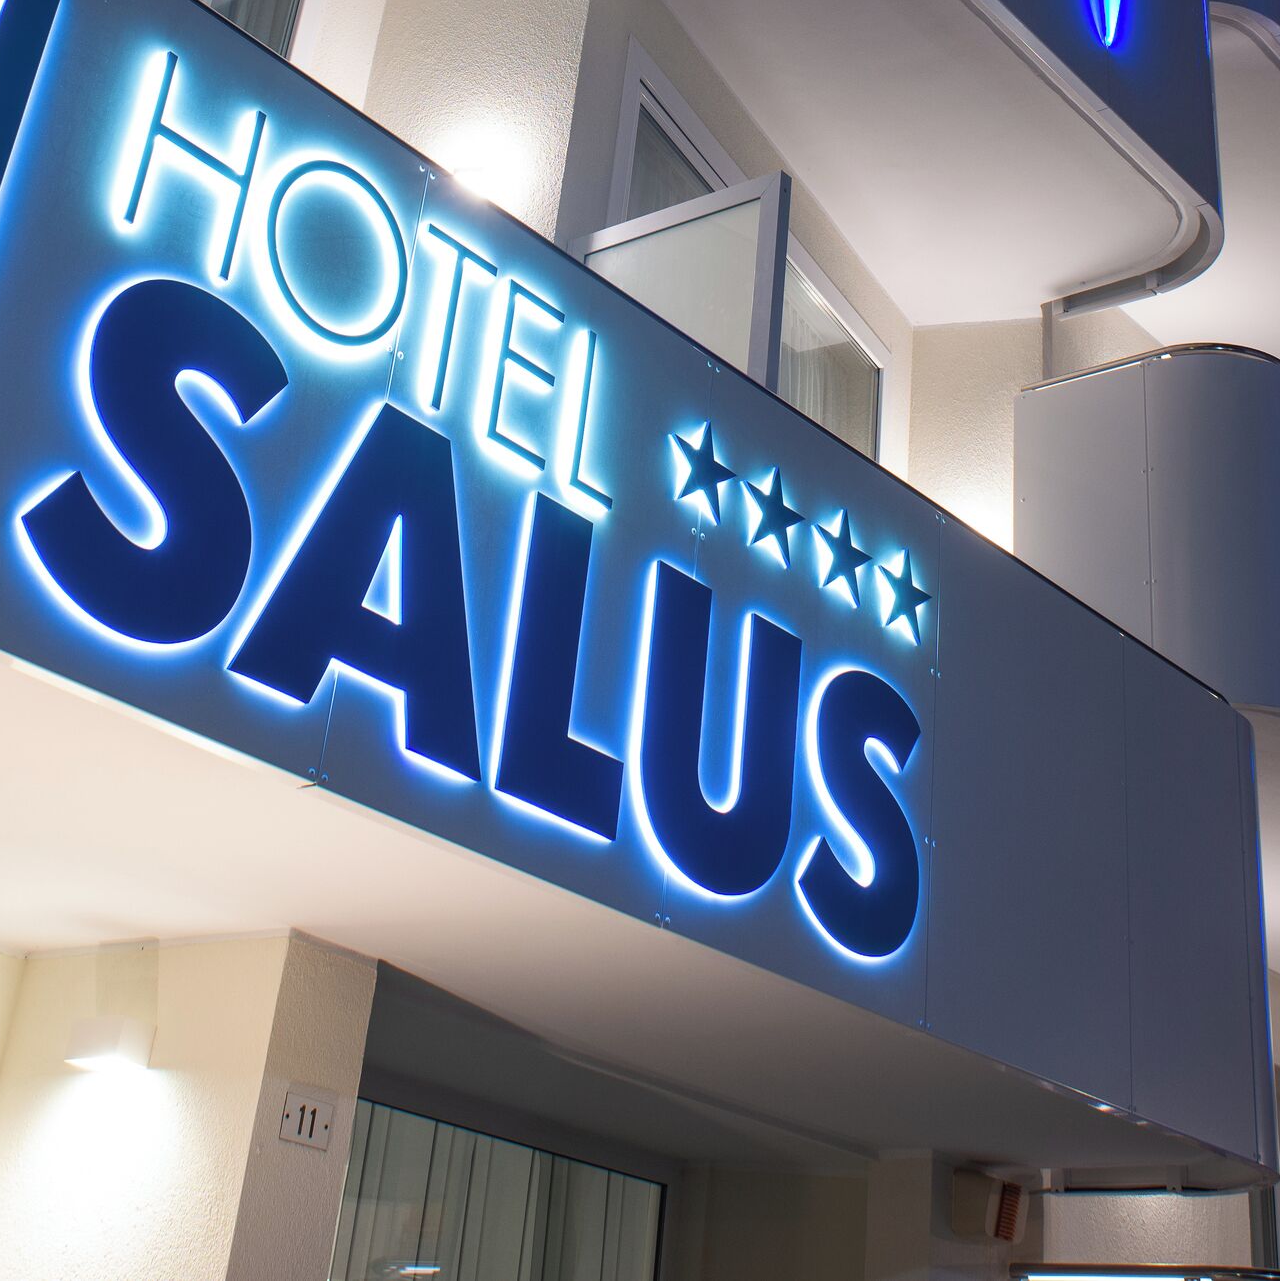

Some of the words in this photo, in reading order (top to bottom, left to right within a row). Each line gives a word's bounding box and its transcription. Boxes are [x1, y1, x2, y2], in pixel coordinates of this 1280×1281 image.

[121, 50, 613, 512] HOTEL
[20, 279, 920, 958] SALUS
[297, 1104, 317, 1138] 11
